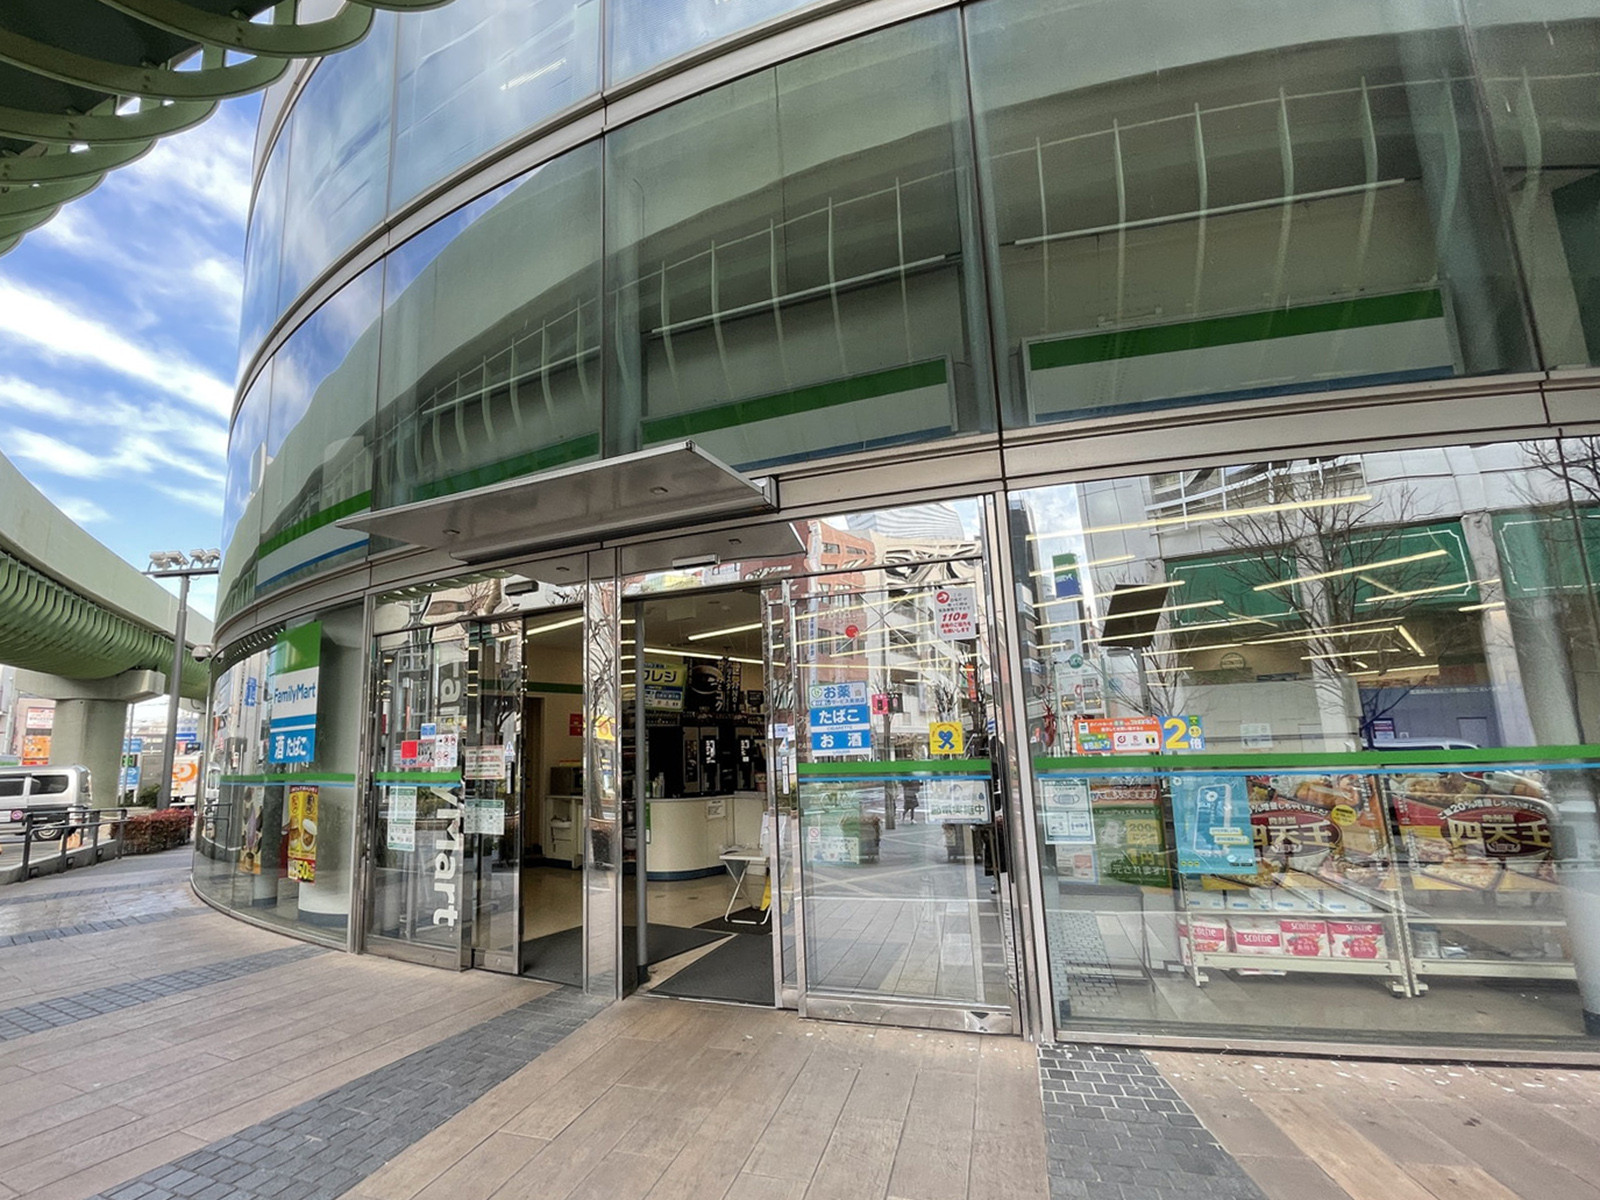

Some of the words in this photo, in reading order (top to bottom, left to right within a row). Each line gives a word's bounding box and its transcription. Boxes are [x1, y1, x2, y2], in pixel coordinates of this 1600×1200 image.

[274, 683, 316, 704] FamilyMart
[823, 685, 851, 699] お薬
[819, 709, 860, 724] たばこ
[820, 734, 834, 748] お
[1164, 717, 1190, 750] 2
[286, 735, 308, 757] たばこ
[1448, 818, 1551, 849] 四天王
[1191, 927, 1217, 938] cottie
[1243, 933, 1273, 944] scottie
